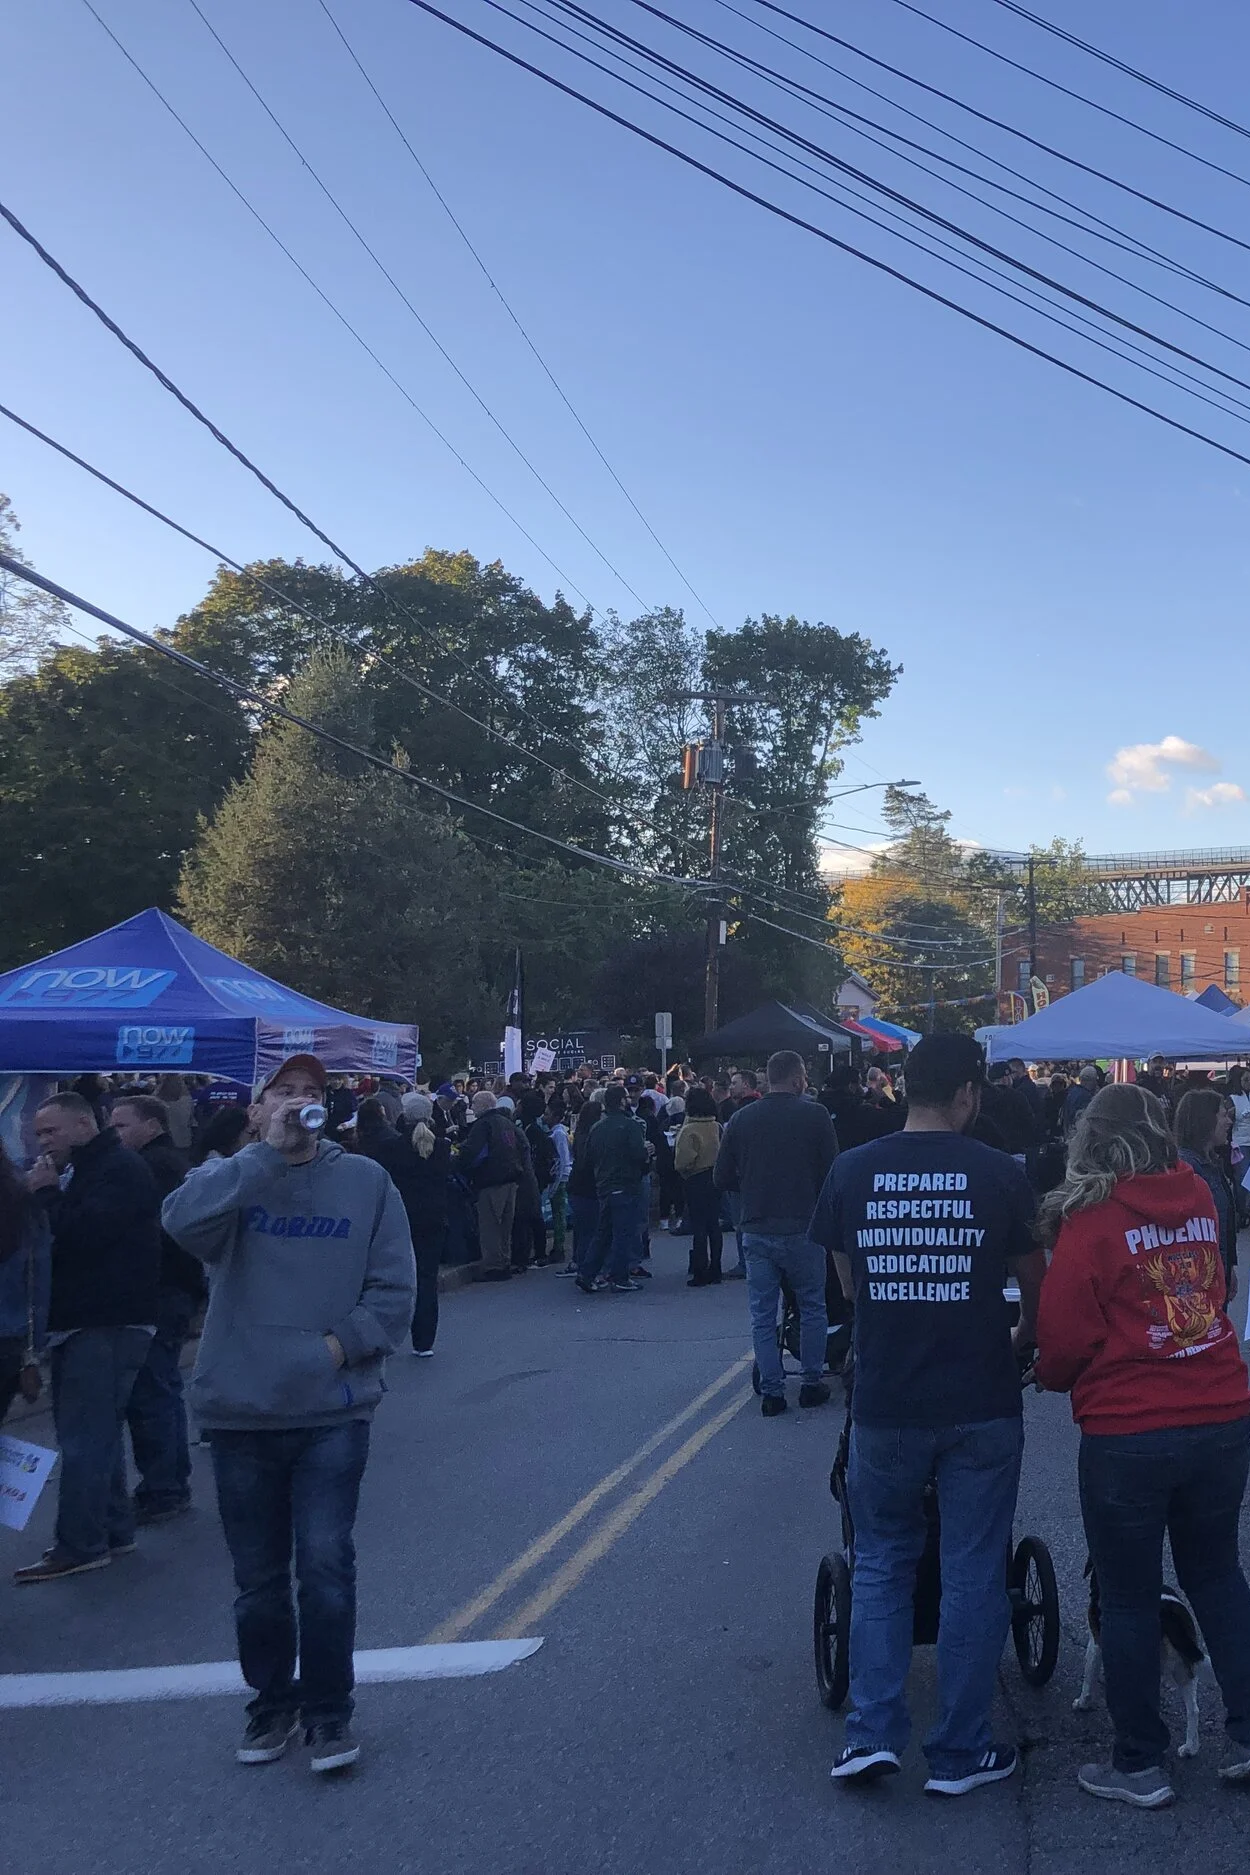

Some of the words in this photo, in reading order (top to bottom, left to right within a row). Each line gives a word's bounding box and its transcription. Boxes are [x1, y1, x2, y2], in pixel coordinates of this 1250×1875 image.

[124, 1027, 189, 1045] now
[526, 1038, 585, 1051] SOCIAL
[873, 1173, 968, 1192] PREPARED
[866, 1200, 974, 1220] RESPECTFUL
[857, 1228, 985, 1247] INDIVIDUALITY
[867, 1255, 972, 1274] DEDICATION
[869, 1281, 970, 1301] EXCELLENCE
